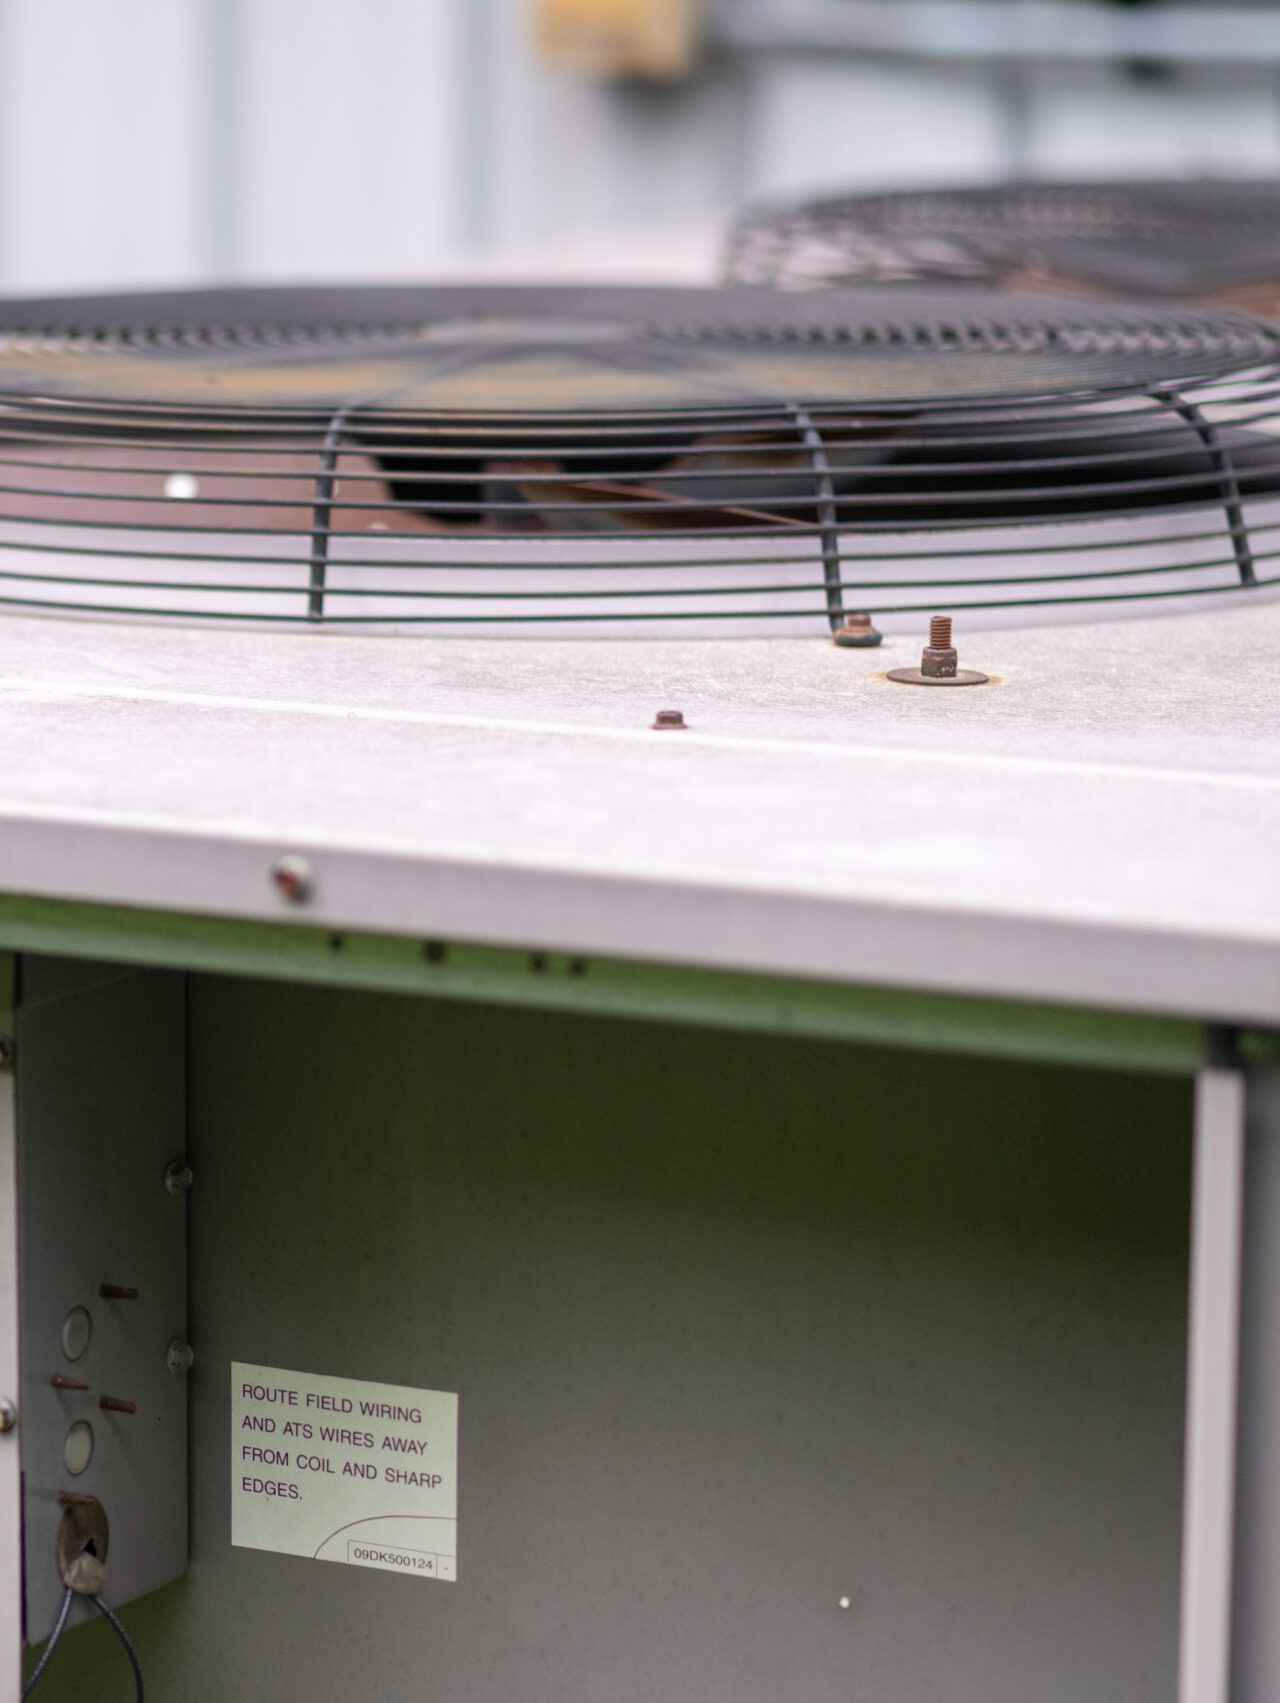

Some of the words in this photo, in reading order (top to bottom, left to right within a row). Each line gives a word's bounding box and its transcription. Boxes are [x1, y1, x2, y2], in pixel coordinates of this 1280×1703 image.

[242, 1384, 298, 1405] ROUTE
[306, 1393, 353, 1413] FIELD
[359, 1401, 422, 1423] WIRING
[242, 1416, 276, 1433] AND
[283, 1421, 313, 1439] ATS
[320, 1426, 374, 1448] WIRES
[382, 1436, 427, 1455] AWAY
[242, 1445, 289, 1467] FROM
[296, 1454, 334, 1473] COIL
[342, 1462, 377, 1480] AND
[385, 1468, 442, 1489] SHARP
[242, 1477, 302, 1500] EDGES.
[354, 1548, 433, 1570] 09DK500124
